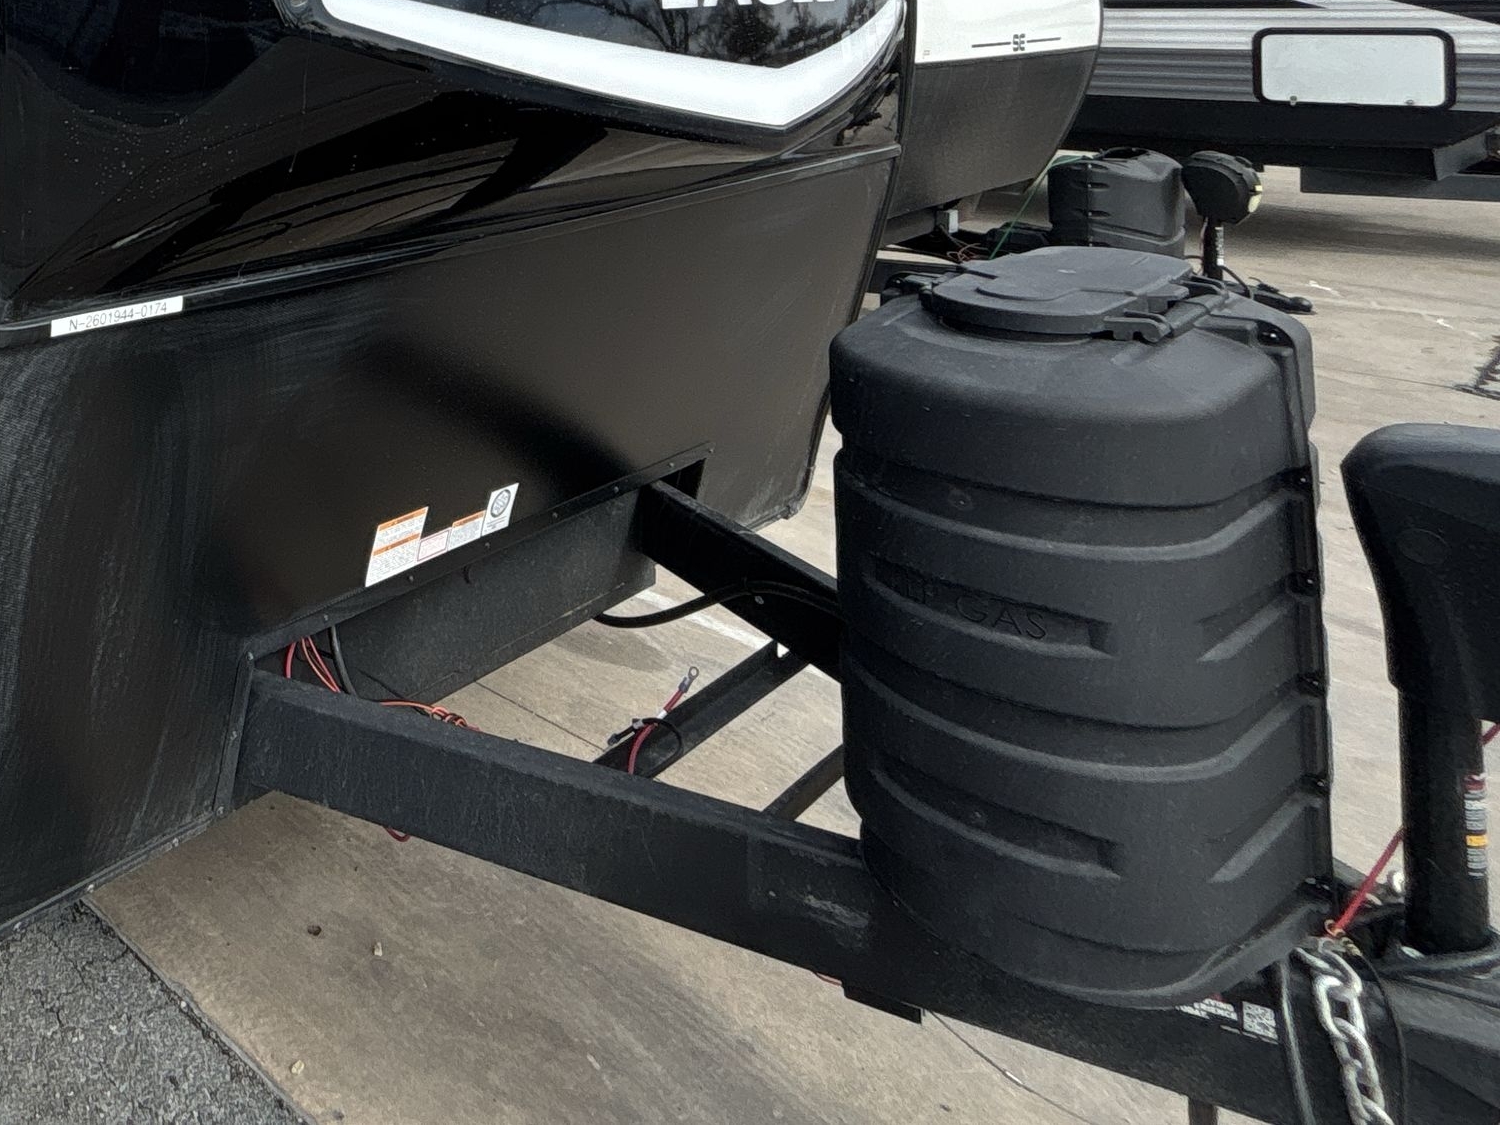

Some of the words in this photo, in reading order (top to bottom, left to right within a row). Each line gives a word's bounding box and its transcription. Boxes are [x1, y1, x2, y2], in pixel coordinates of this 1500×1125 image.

[1013, 33, 1026, 52] SE
[68, 301, 168, 332] N-2601944-0174
[955, 594, 1047, 640] GAS
